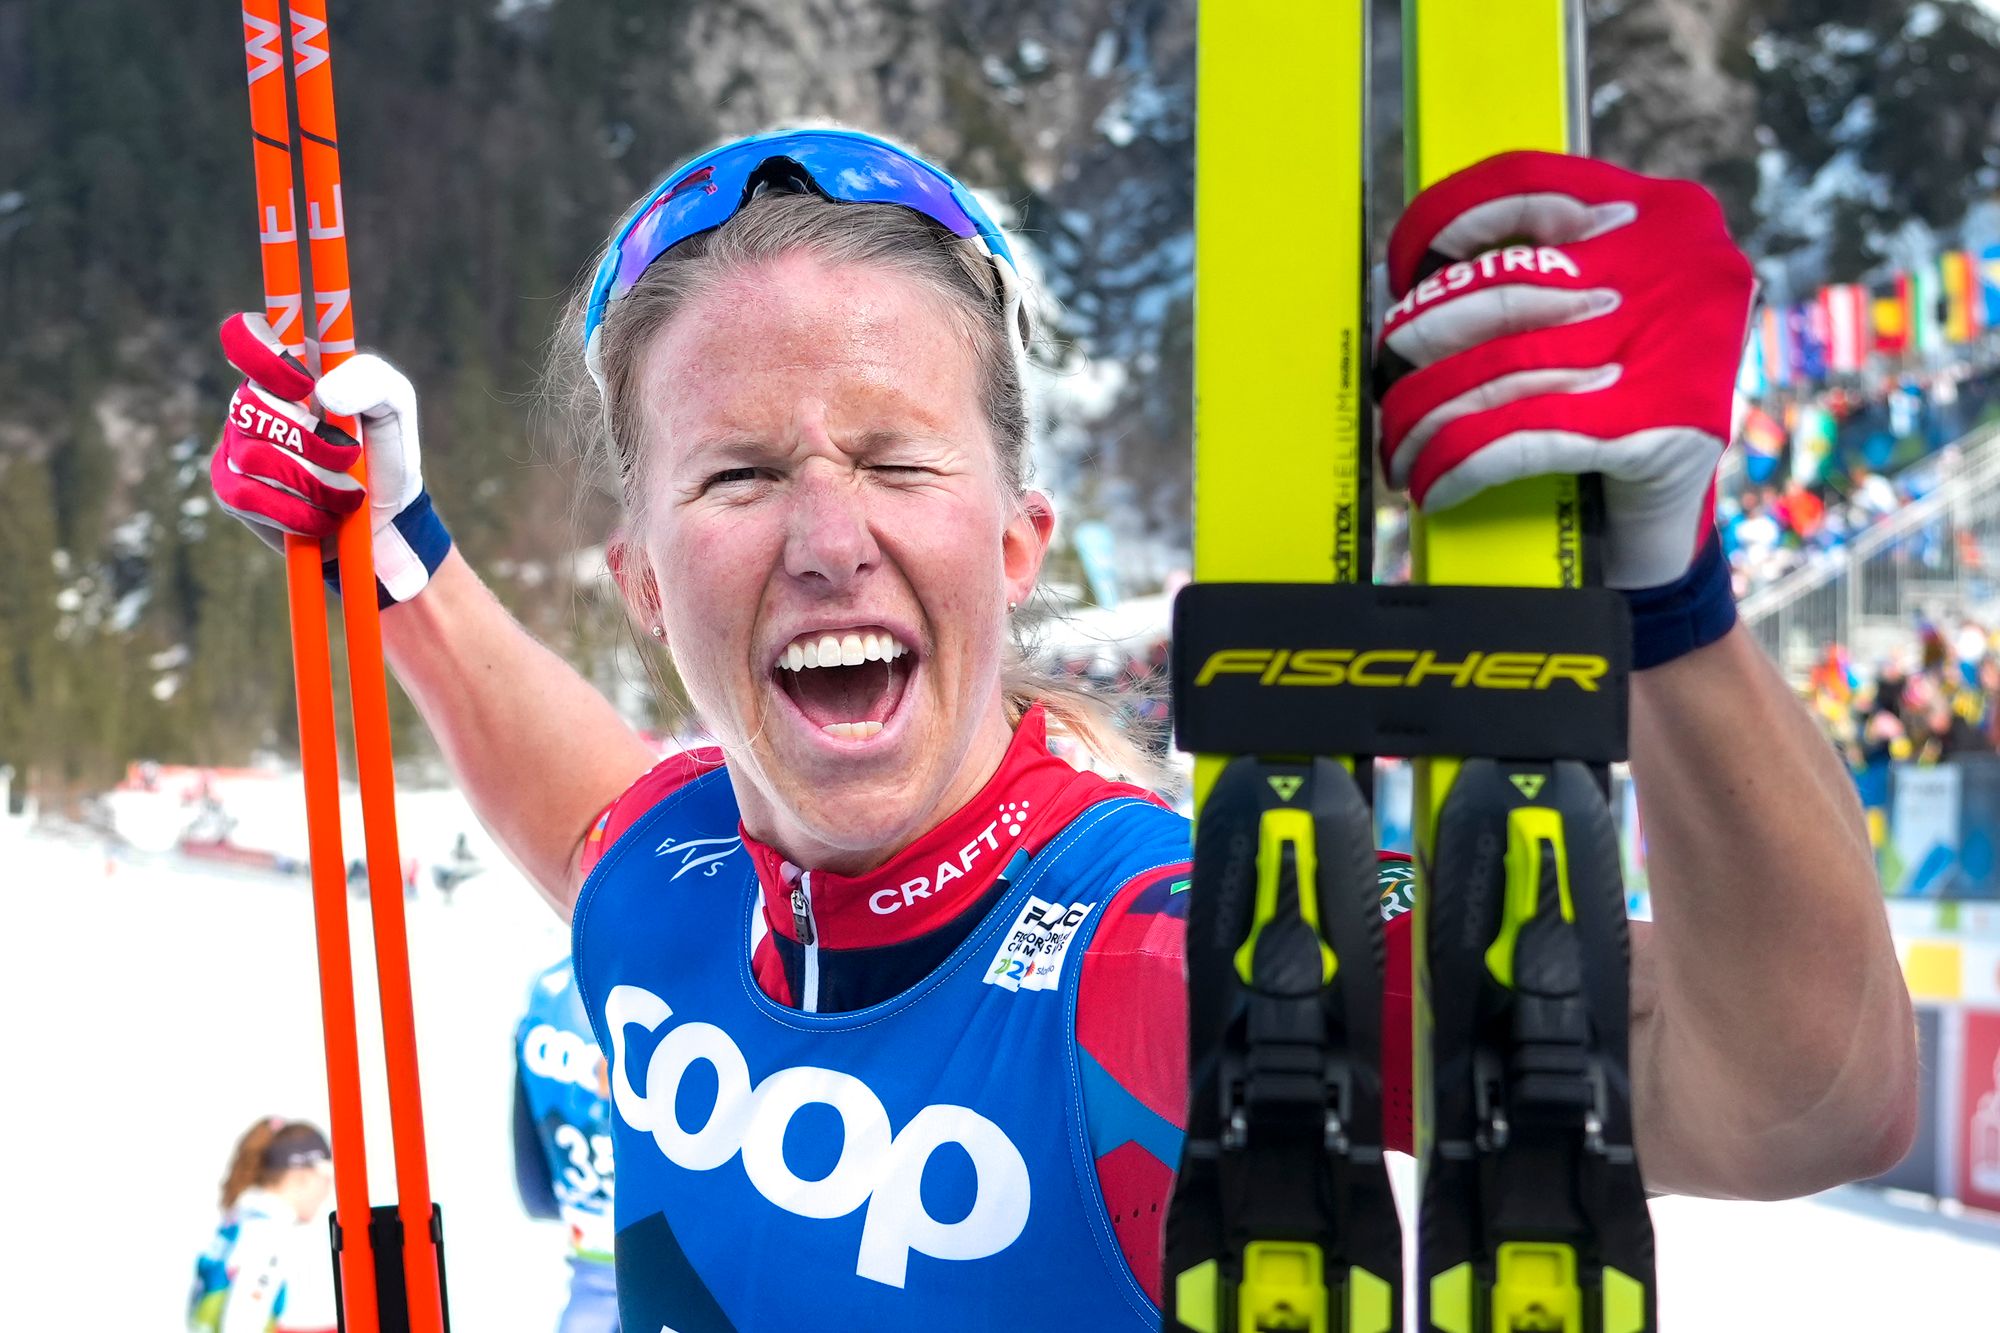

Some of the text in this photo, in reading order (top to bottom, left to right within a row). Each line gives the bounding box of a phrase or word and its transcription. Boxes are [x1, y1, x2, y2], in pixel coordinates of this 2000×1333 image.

[1193, 648, 1609, 692] FISCHER
[868, 820, 999, 915] CRAFT
[605, 985, 1031, 1289] coop
